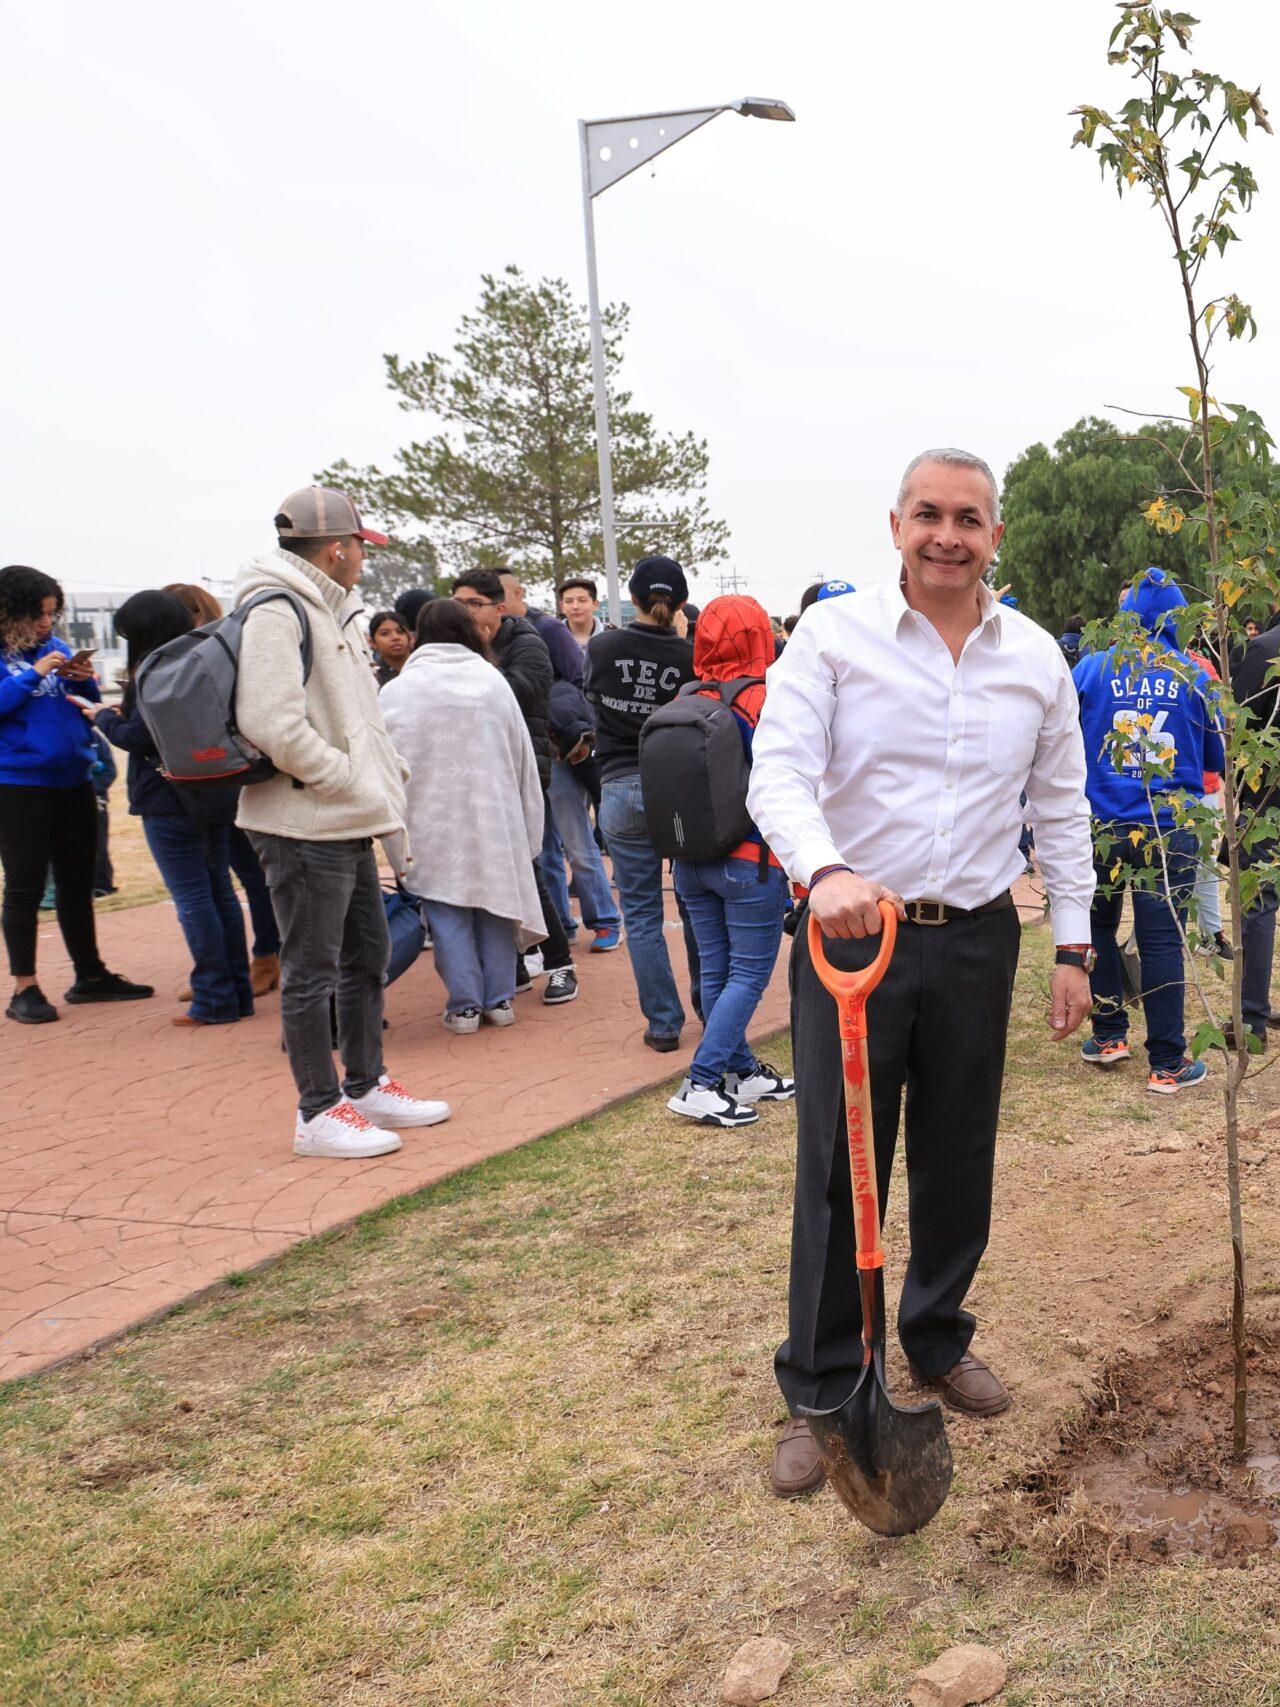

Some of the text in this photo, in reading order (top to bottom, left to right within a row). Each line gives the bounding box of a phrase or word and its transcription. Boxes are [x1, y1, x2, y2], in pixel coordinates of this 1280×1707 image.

[614, 659, 681, 691] TEC
[632, 684, 657, 701] DE
[1110, 677, 1180, 700] CLASS
[1136, 697, 1154, 710] OF
